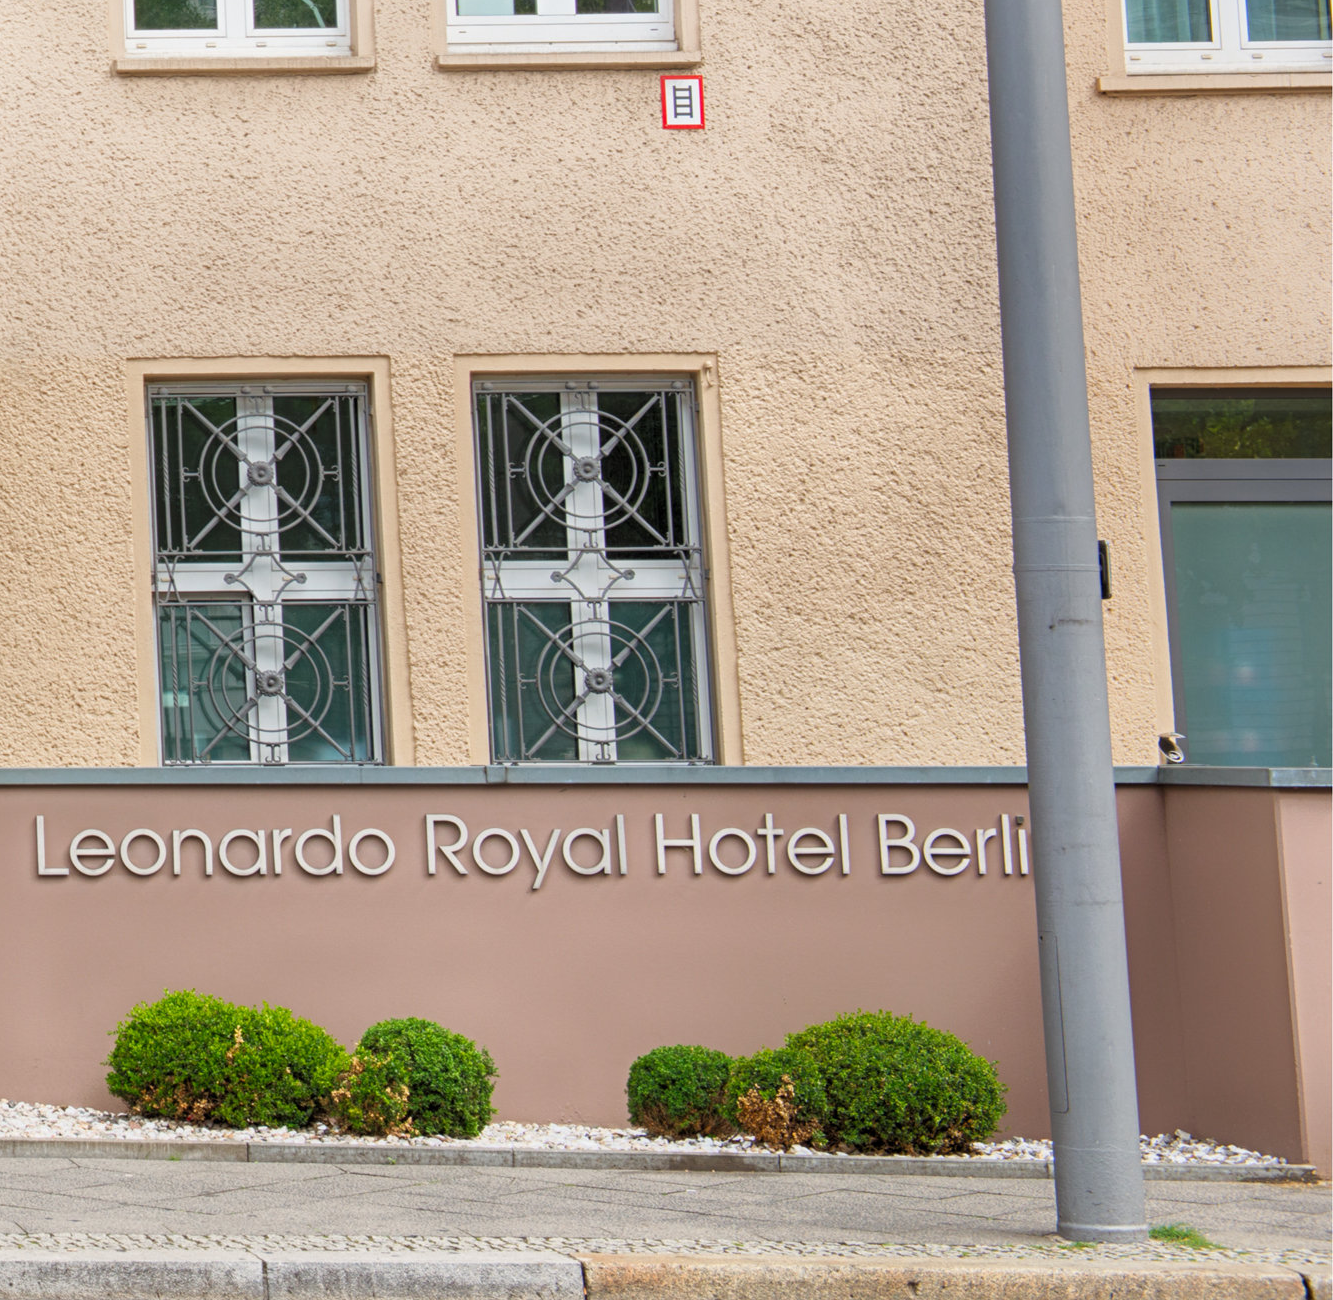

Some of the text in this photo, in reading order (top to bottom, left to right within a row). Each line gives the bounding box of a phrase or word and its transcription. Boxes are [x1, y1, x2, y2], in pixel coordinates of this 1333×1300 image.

[35, 812, 1030, 890] Leonardo Royal Hotel Berli
